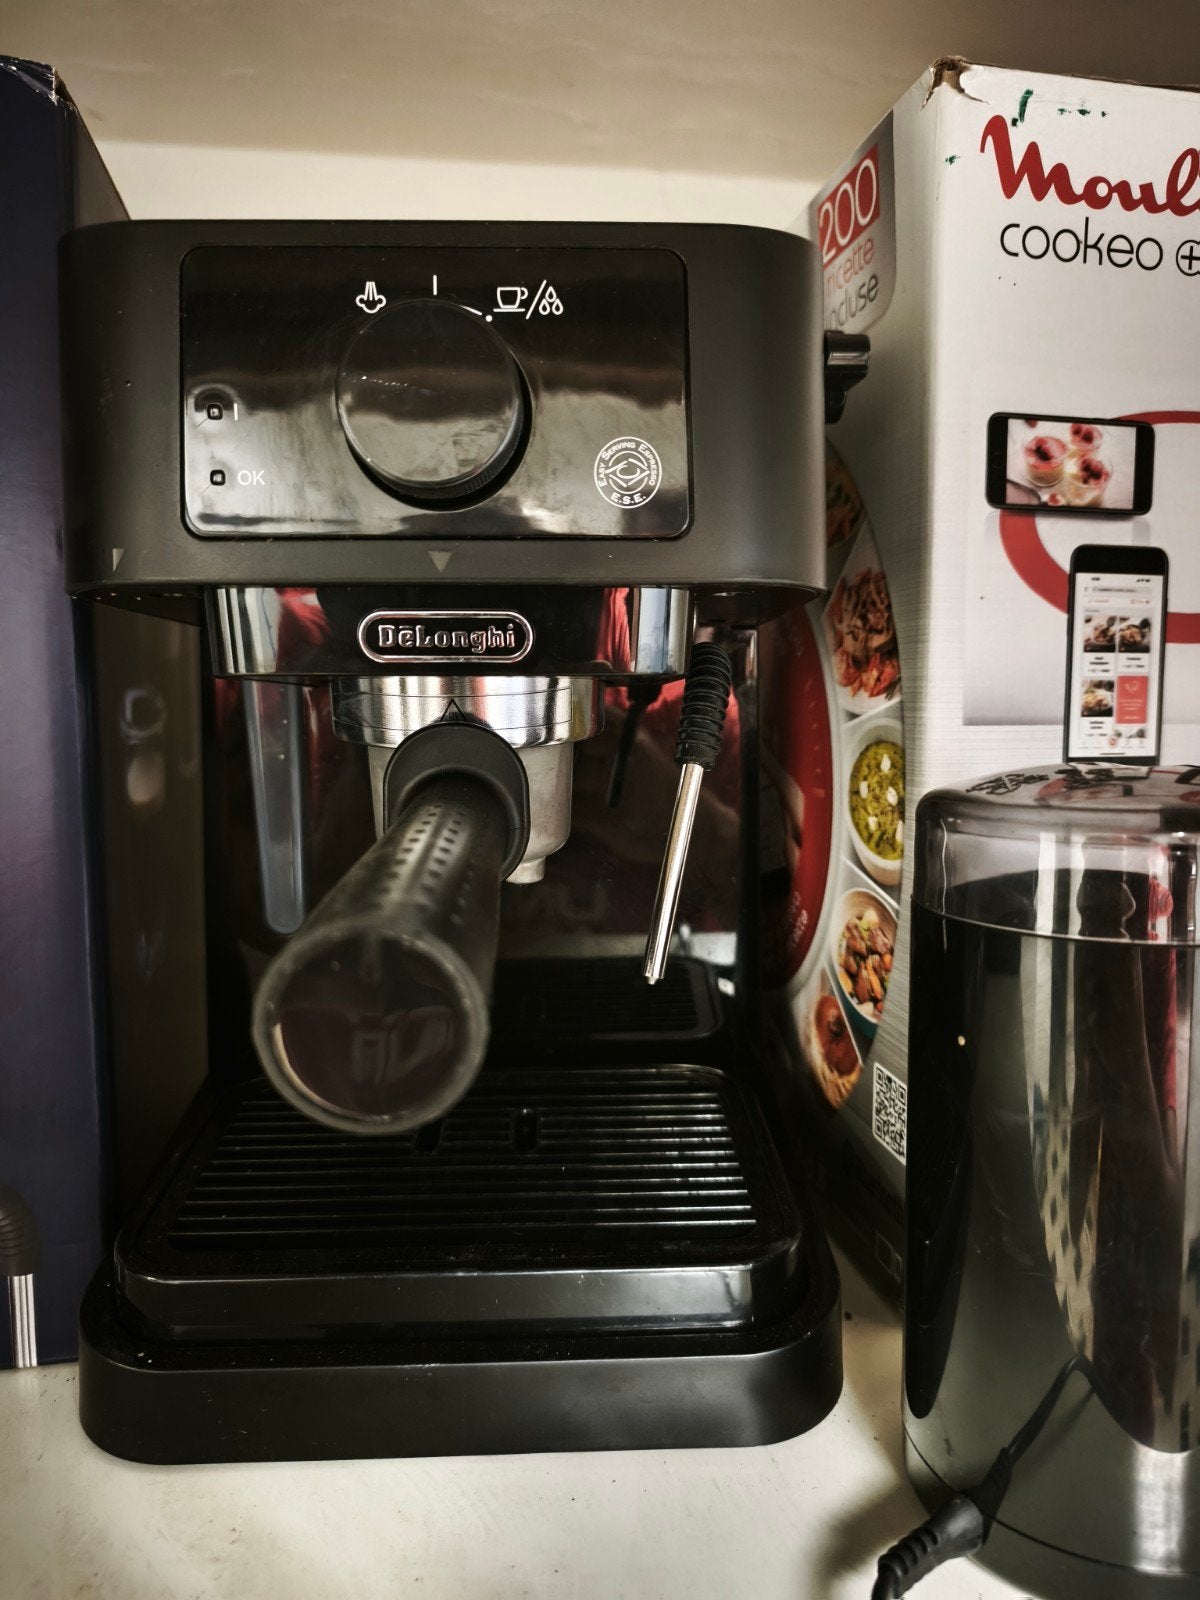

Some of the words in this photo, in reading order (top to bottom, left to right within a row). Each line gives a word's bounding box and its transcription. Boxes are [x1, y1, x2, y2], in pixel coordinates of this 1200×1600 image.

[980, 114, 1200, 217] Moul
[819, 158, 877, 265] 200
[826, 238, 875, 298] ricette
[1000, 216, 1163, 271] cookeo
[237, 469, 266, 486] OK
